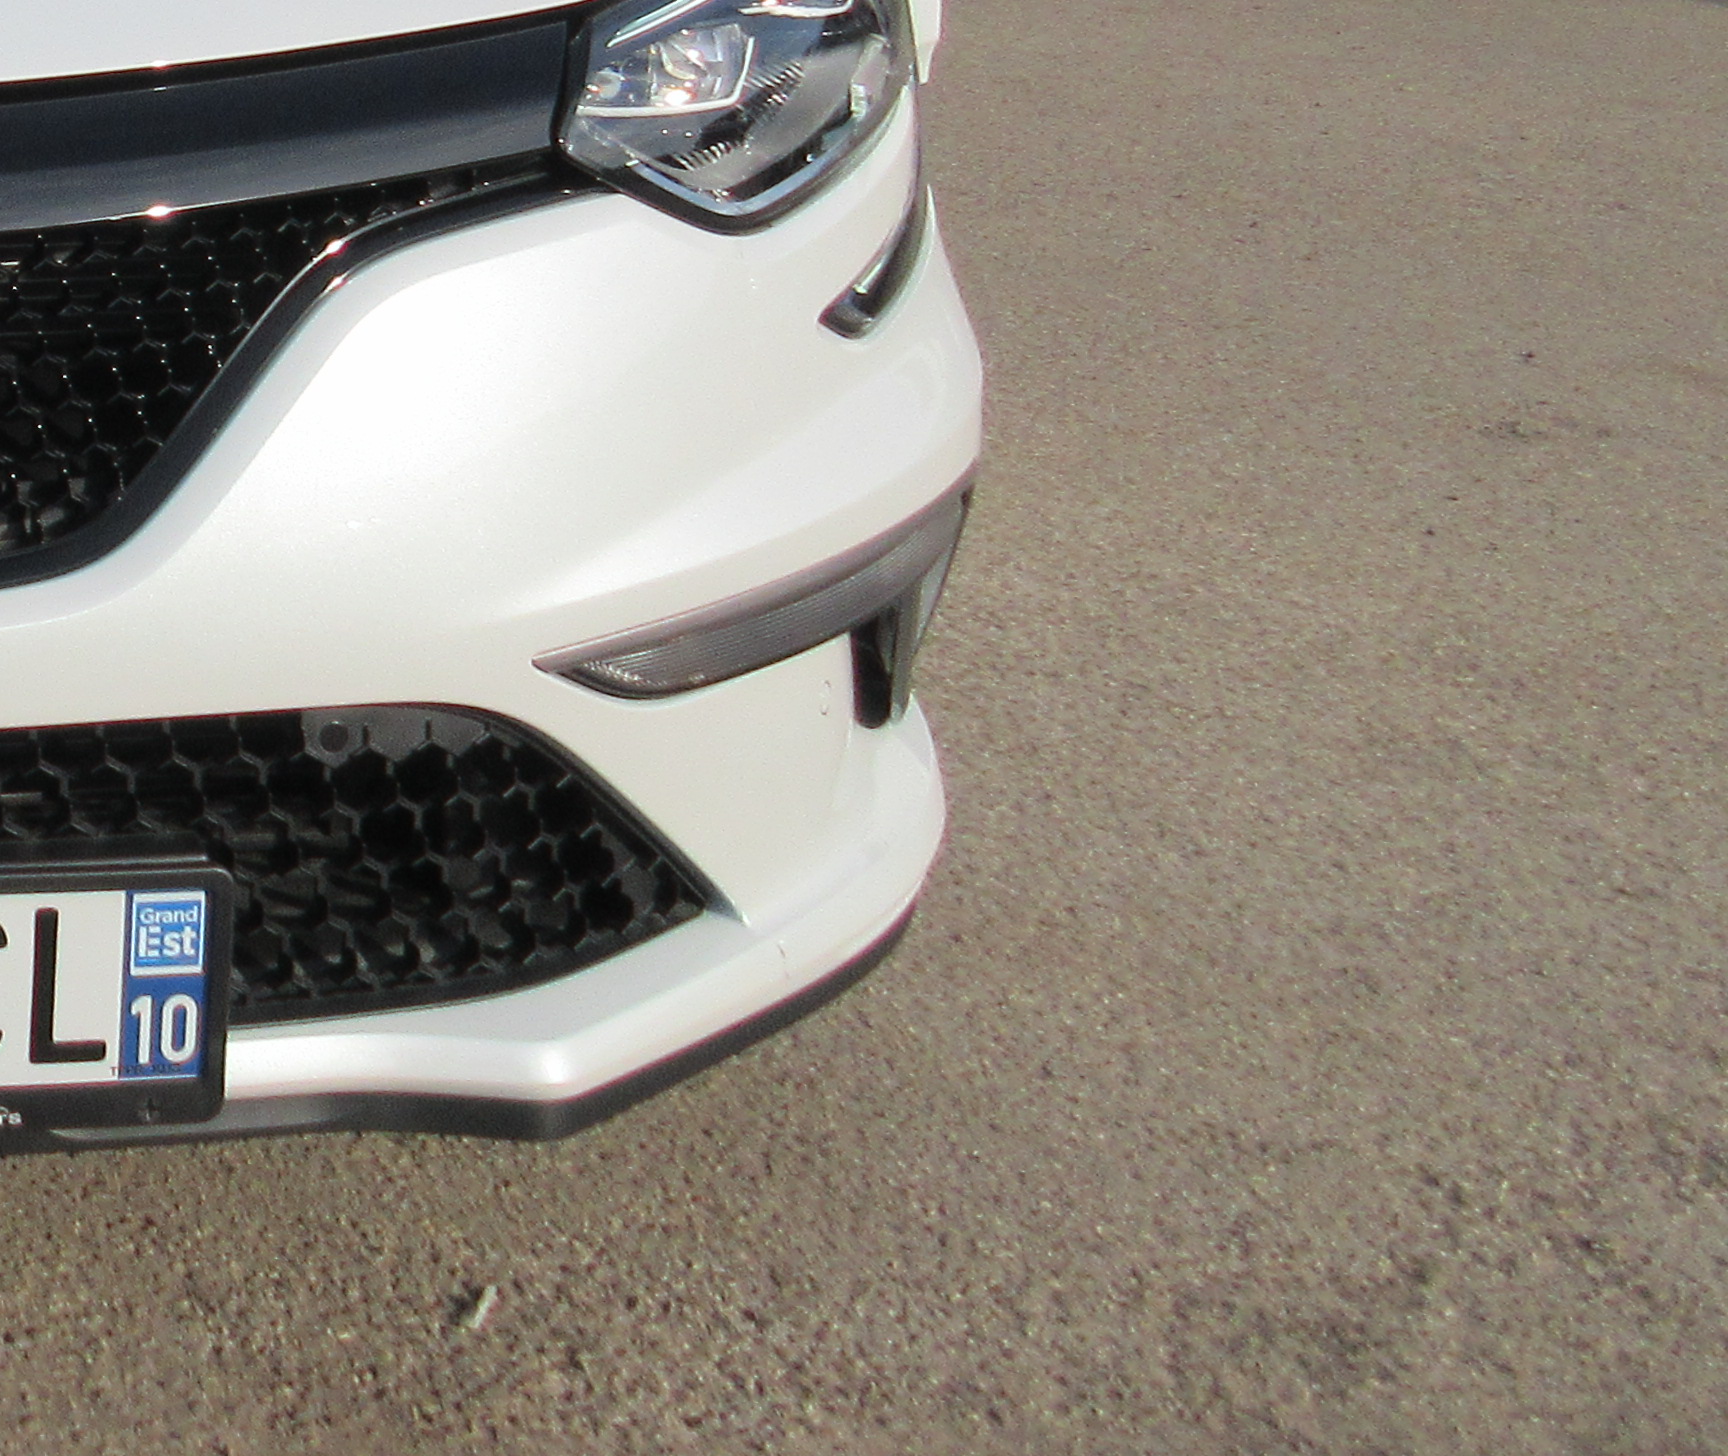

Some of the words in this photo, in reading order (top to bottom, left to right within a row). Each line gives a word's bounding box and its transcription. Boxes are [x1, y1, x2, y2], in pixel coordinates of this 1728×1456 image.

[139, 905, 199, 925] Grand
[138, 925, 197, 959] Est
[130, 994, 198, 1065] 10
